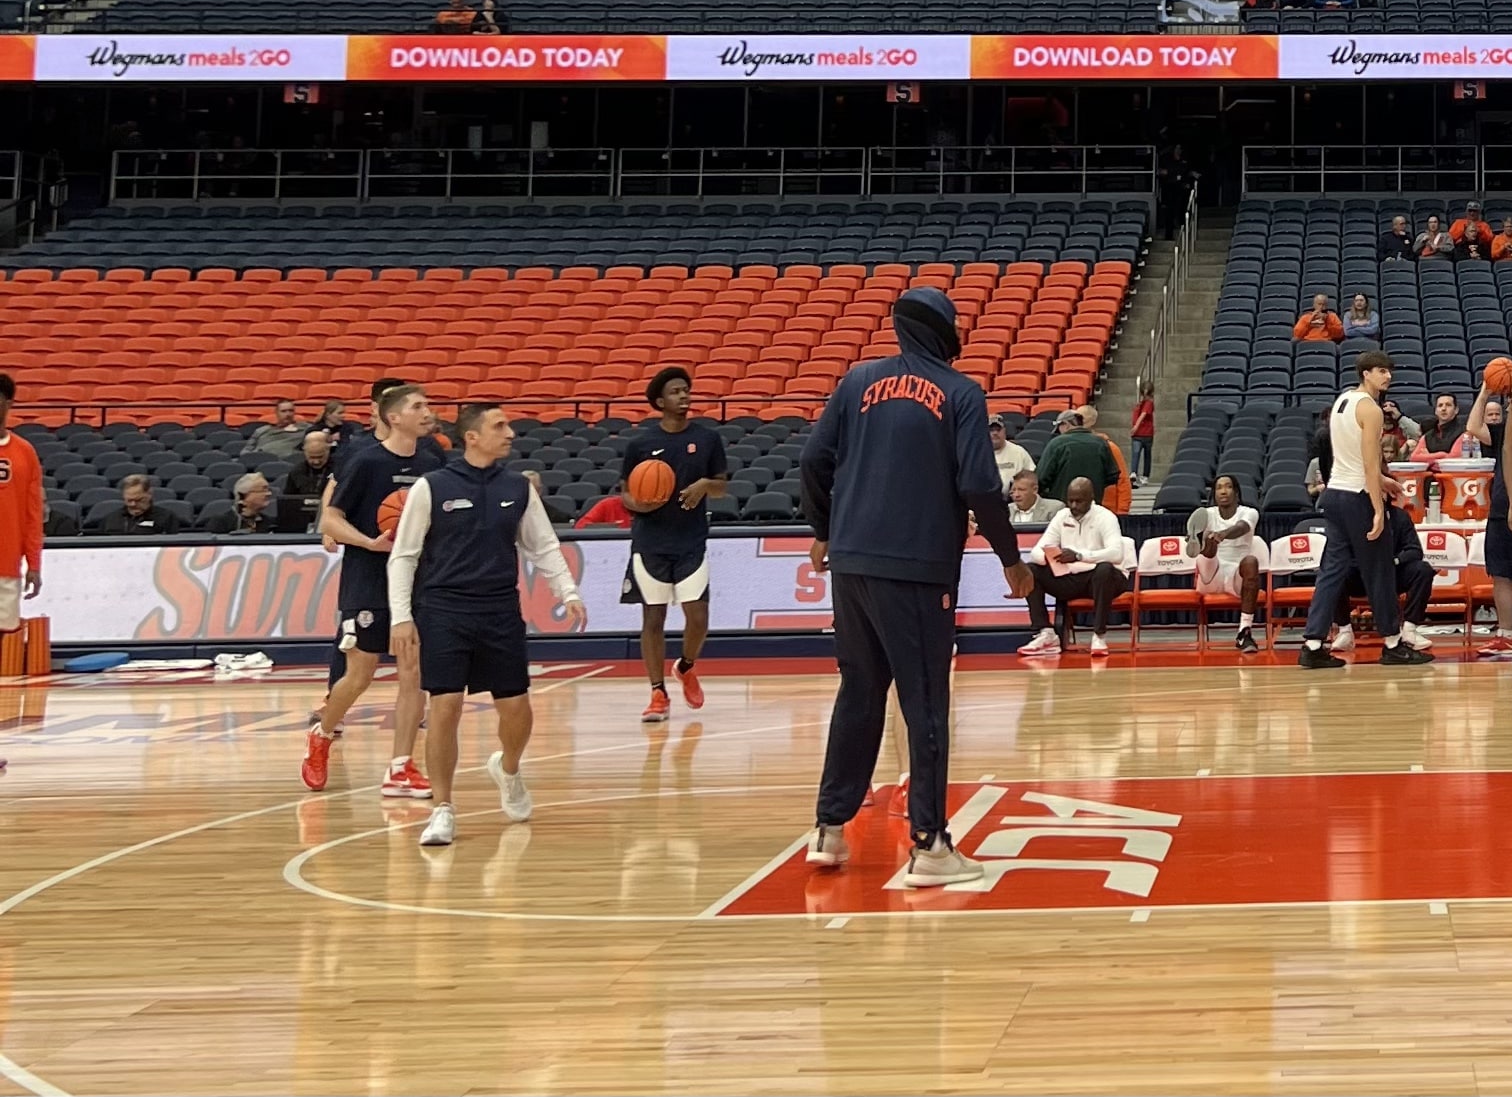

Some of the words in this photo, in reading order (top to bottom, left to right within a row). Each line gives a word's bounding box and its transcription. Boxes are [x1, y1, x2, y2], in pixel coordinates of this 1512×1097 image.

[87, 40, 186, 76] Wegmans
[390, 47, 535, 68] DOWNLOAD
[542, 47, 624, 68] TODAY
[717, 40, 814, 76] Wegmans
[1014, 46, 1153, 67] DOWNLOAD
[1160, 46, 1238, 67] TODAY
[1328, 39, 1421, 74] Wegmans
[861, 374, 946, 420] SYRACUSE
[1463, 479, 1478, 496] G
[795, 562, 826, 602] S
